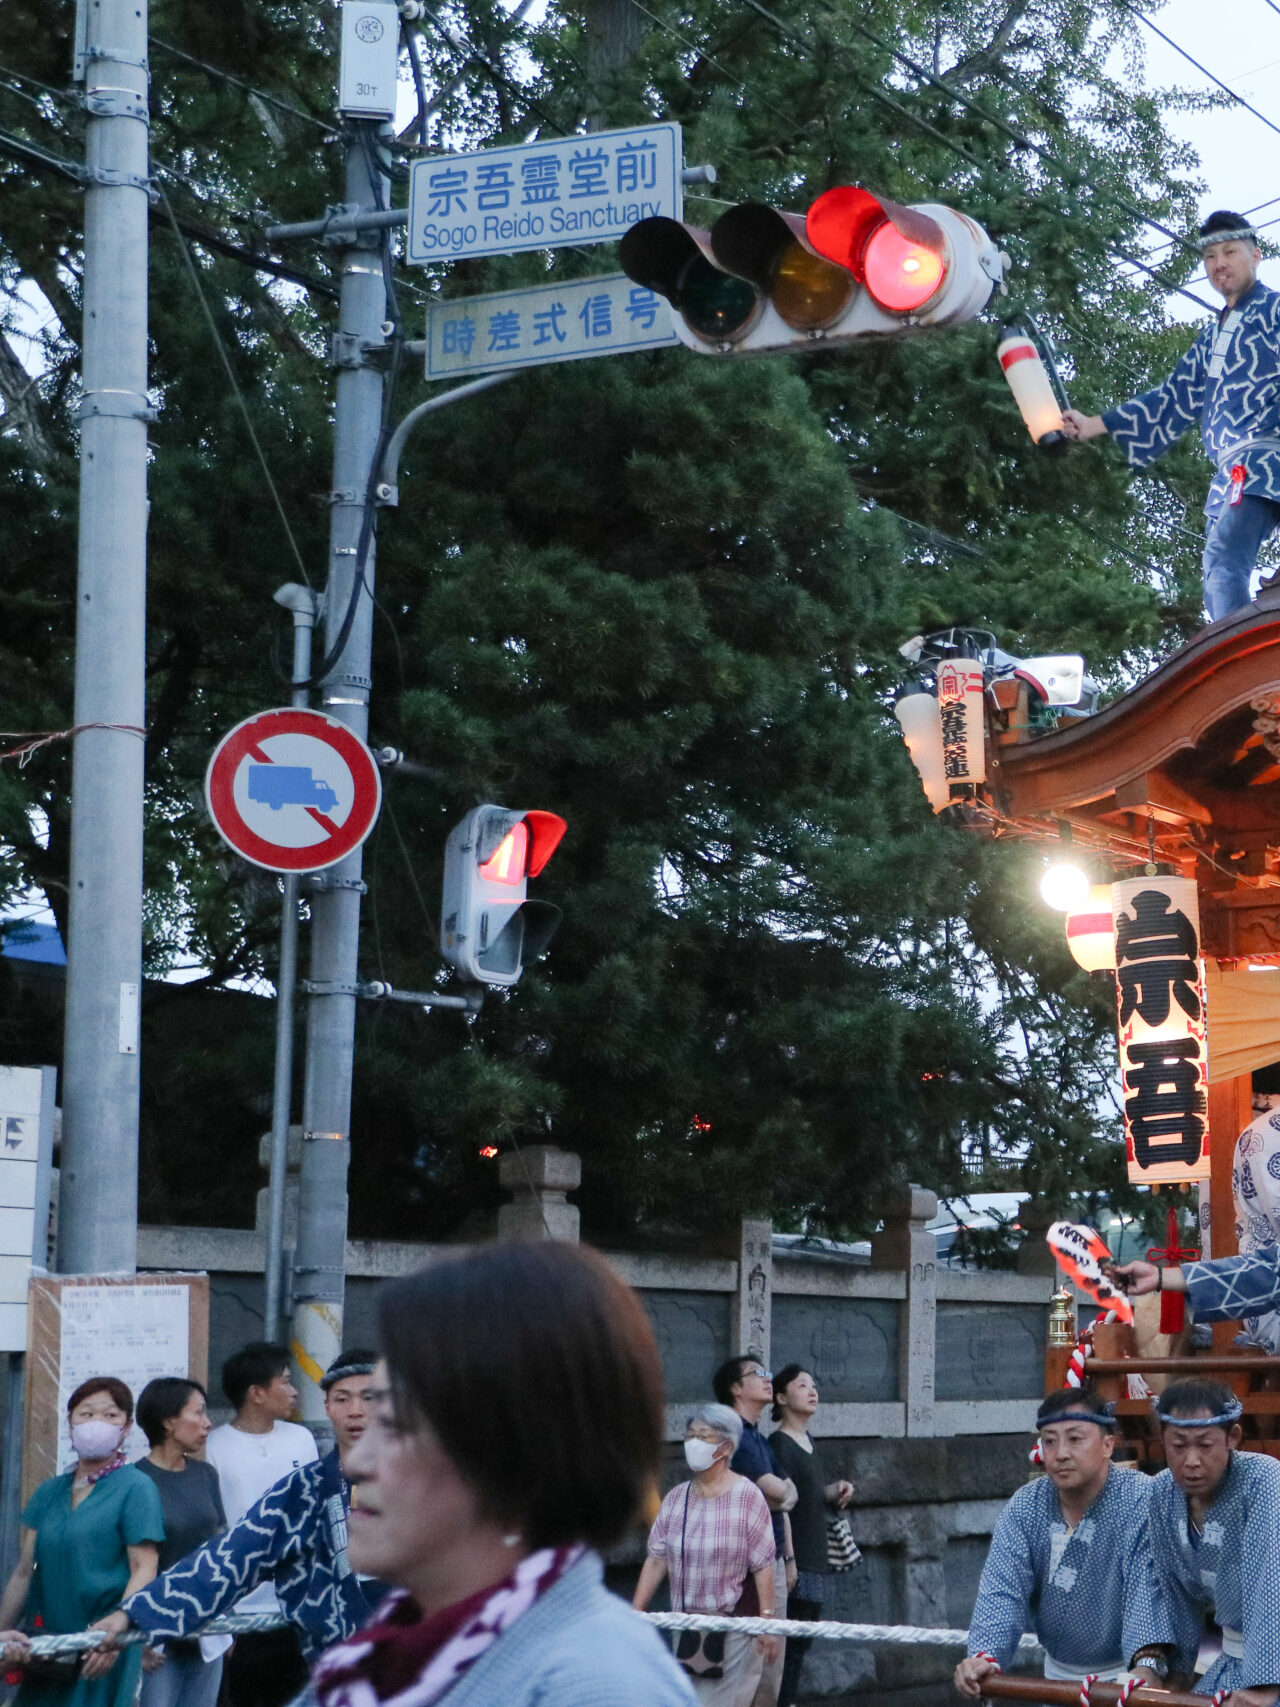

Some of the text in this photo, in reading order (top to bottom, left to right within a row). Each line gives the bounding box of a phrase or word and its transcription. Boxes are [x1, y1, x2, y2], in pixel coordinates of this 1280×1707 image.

[427, 139, 658, 217] 宗吾霊堂前
[423, 201, 661, 250] Sogo Reido Sanctuary
[442, 288, 660, 355] 時差式信号
[1115, 890, 1206, 1169] 宗吾
